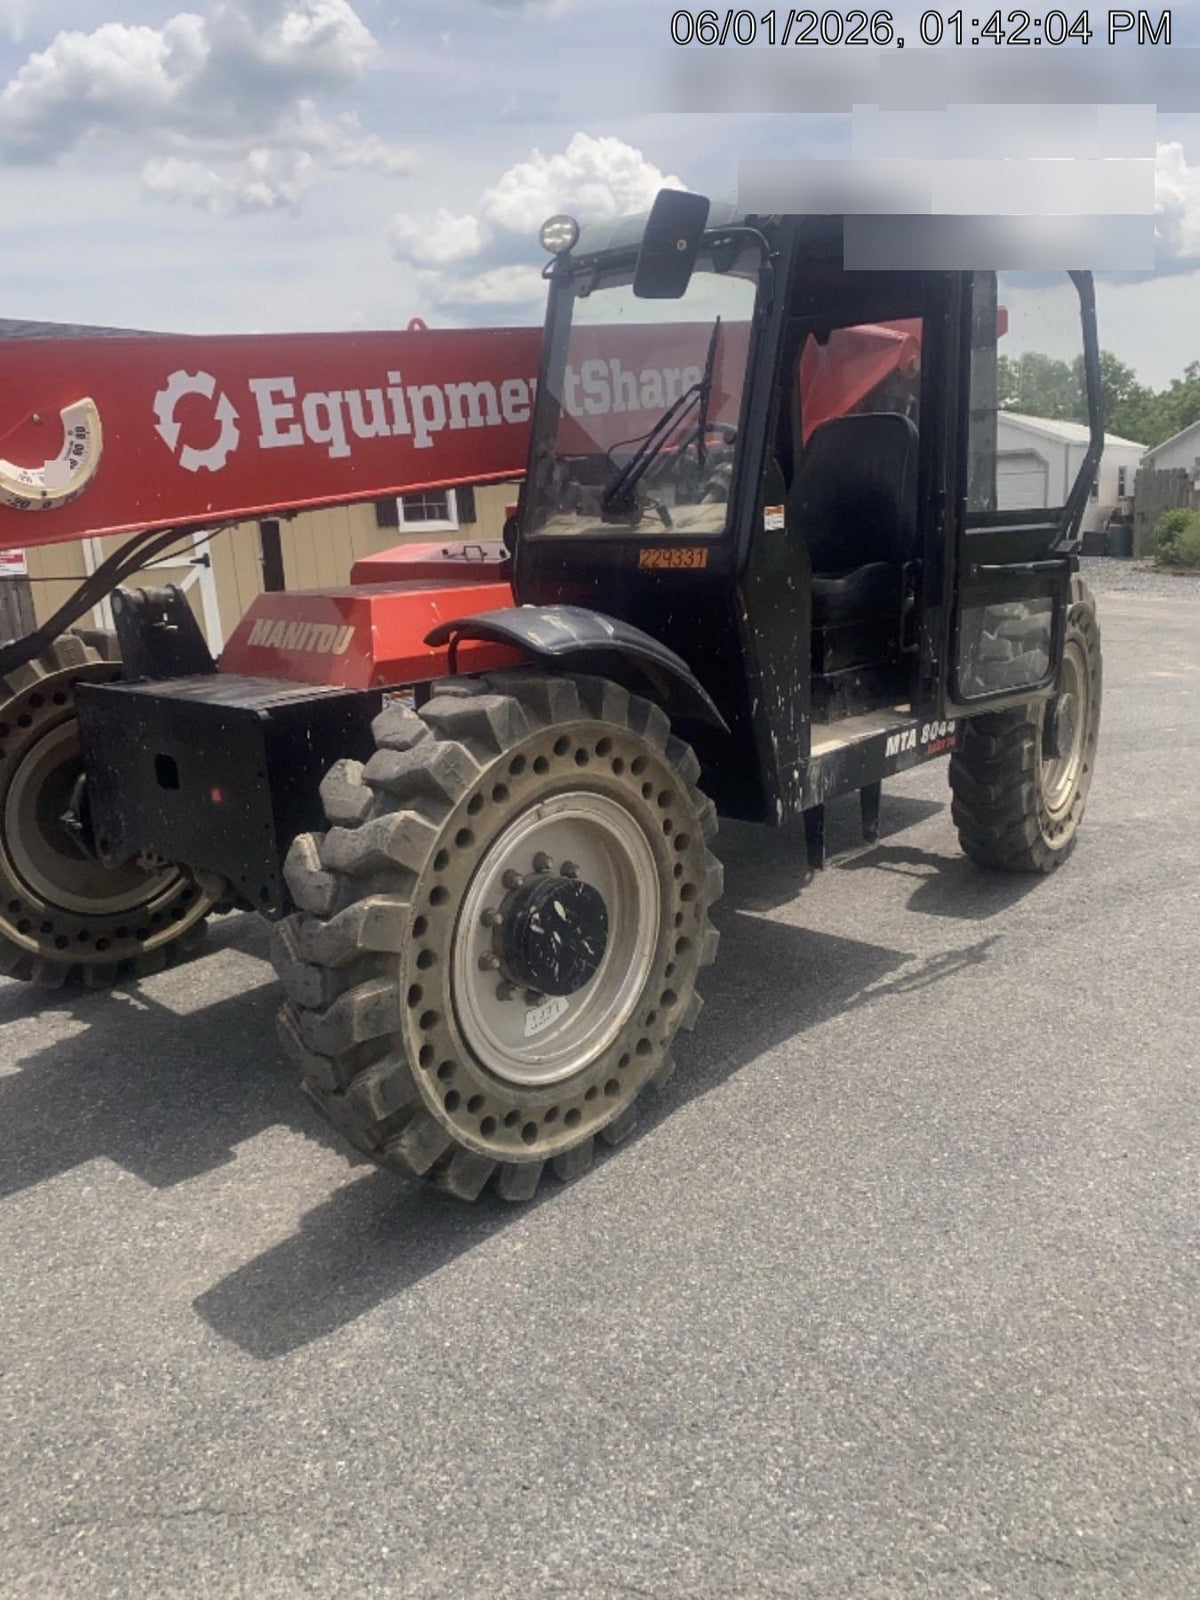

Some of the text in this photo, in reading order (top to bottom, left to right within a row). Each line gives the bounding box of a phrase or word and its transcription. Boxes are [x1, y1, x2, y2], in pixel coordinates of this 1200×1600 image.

[248, 358, 703, 458] EquipmetShare
[640, 549, 706, 567] 224331
[247, 618, 356, 655] MANITOU
[885, 728, 917, 758] MTA
[920, 720, 955, 744] 8044
